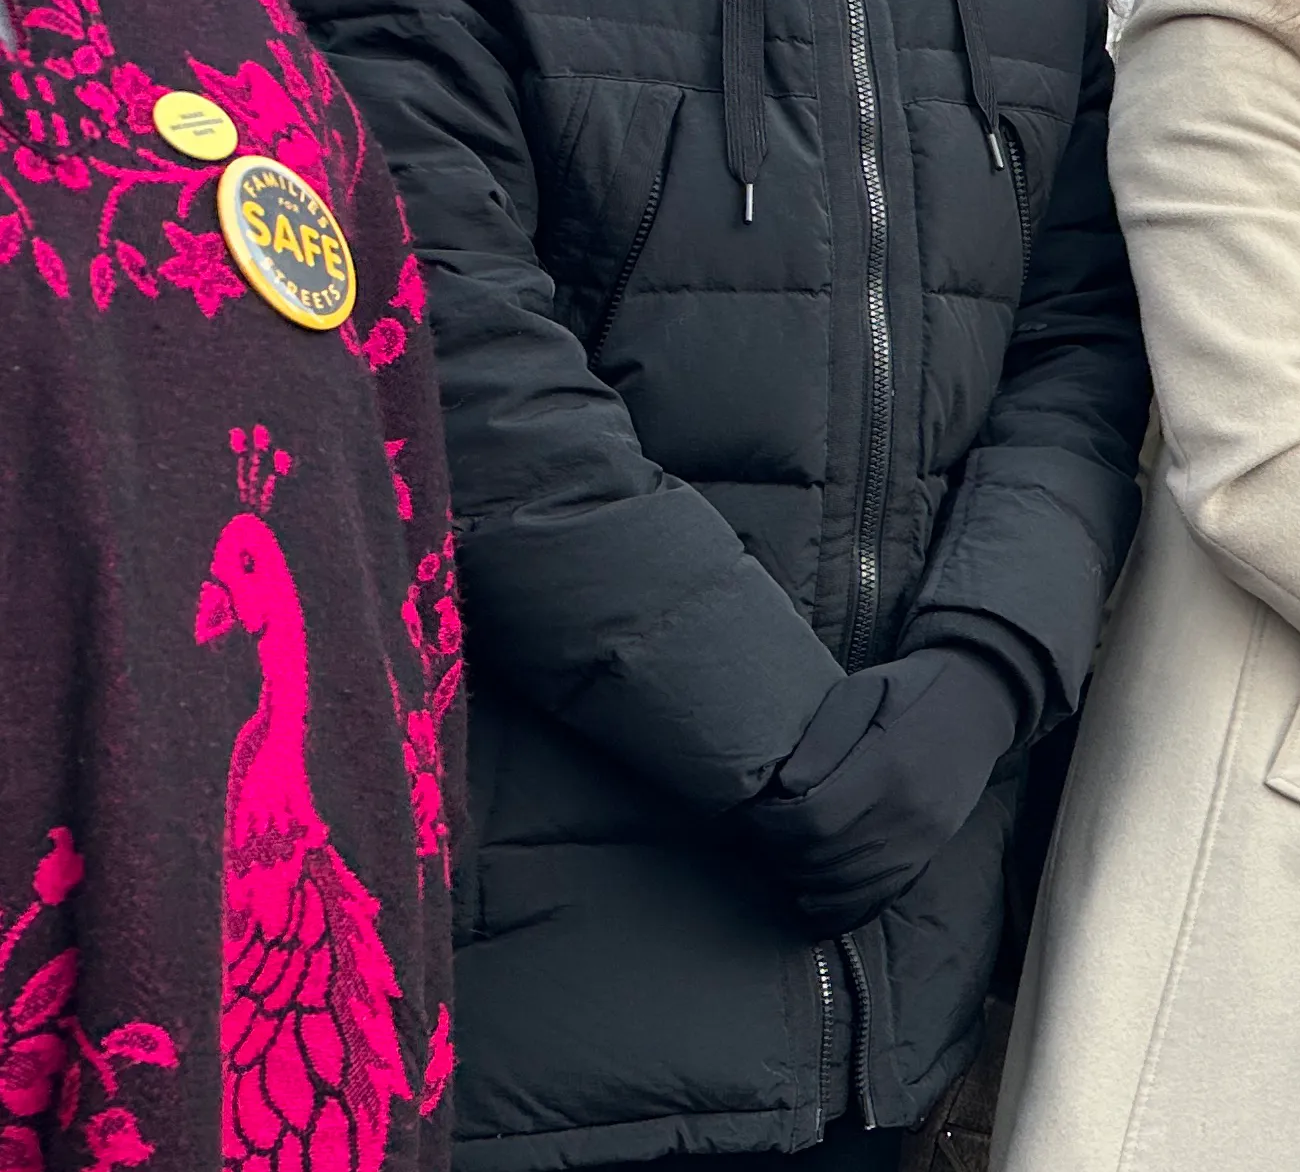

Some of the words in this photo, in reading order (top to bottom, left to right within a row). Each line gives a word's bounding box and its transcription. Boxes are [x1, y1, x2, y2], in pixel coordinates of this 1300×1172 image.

[242, 169, 330, 230] FAMILIES
[241, 200, 346, 283] SAFE
[261, 256, 342, 310] STREETS
